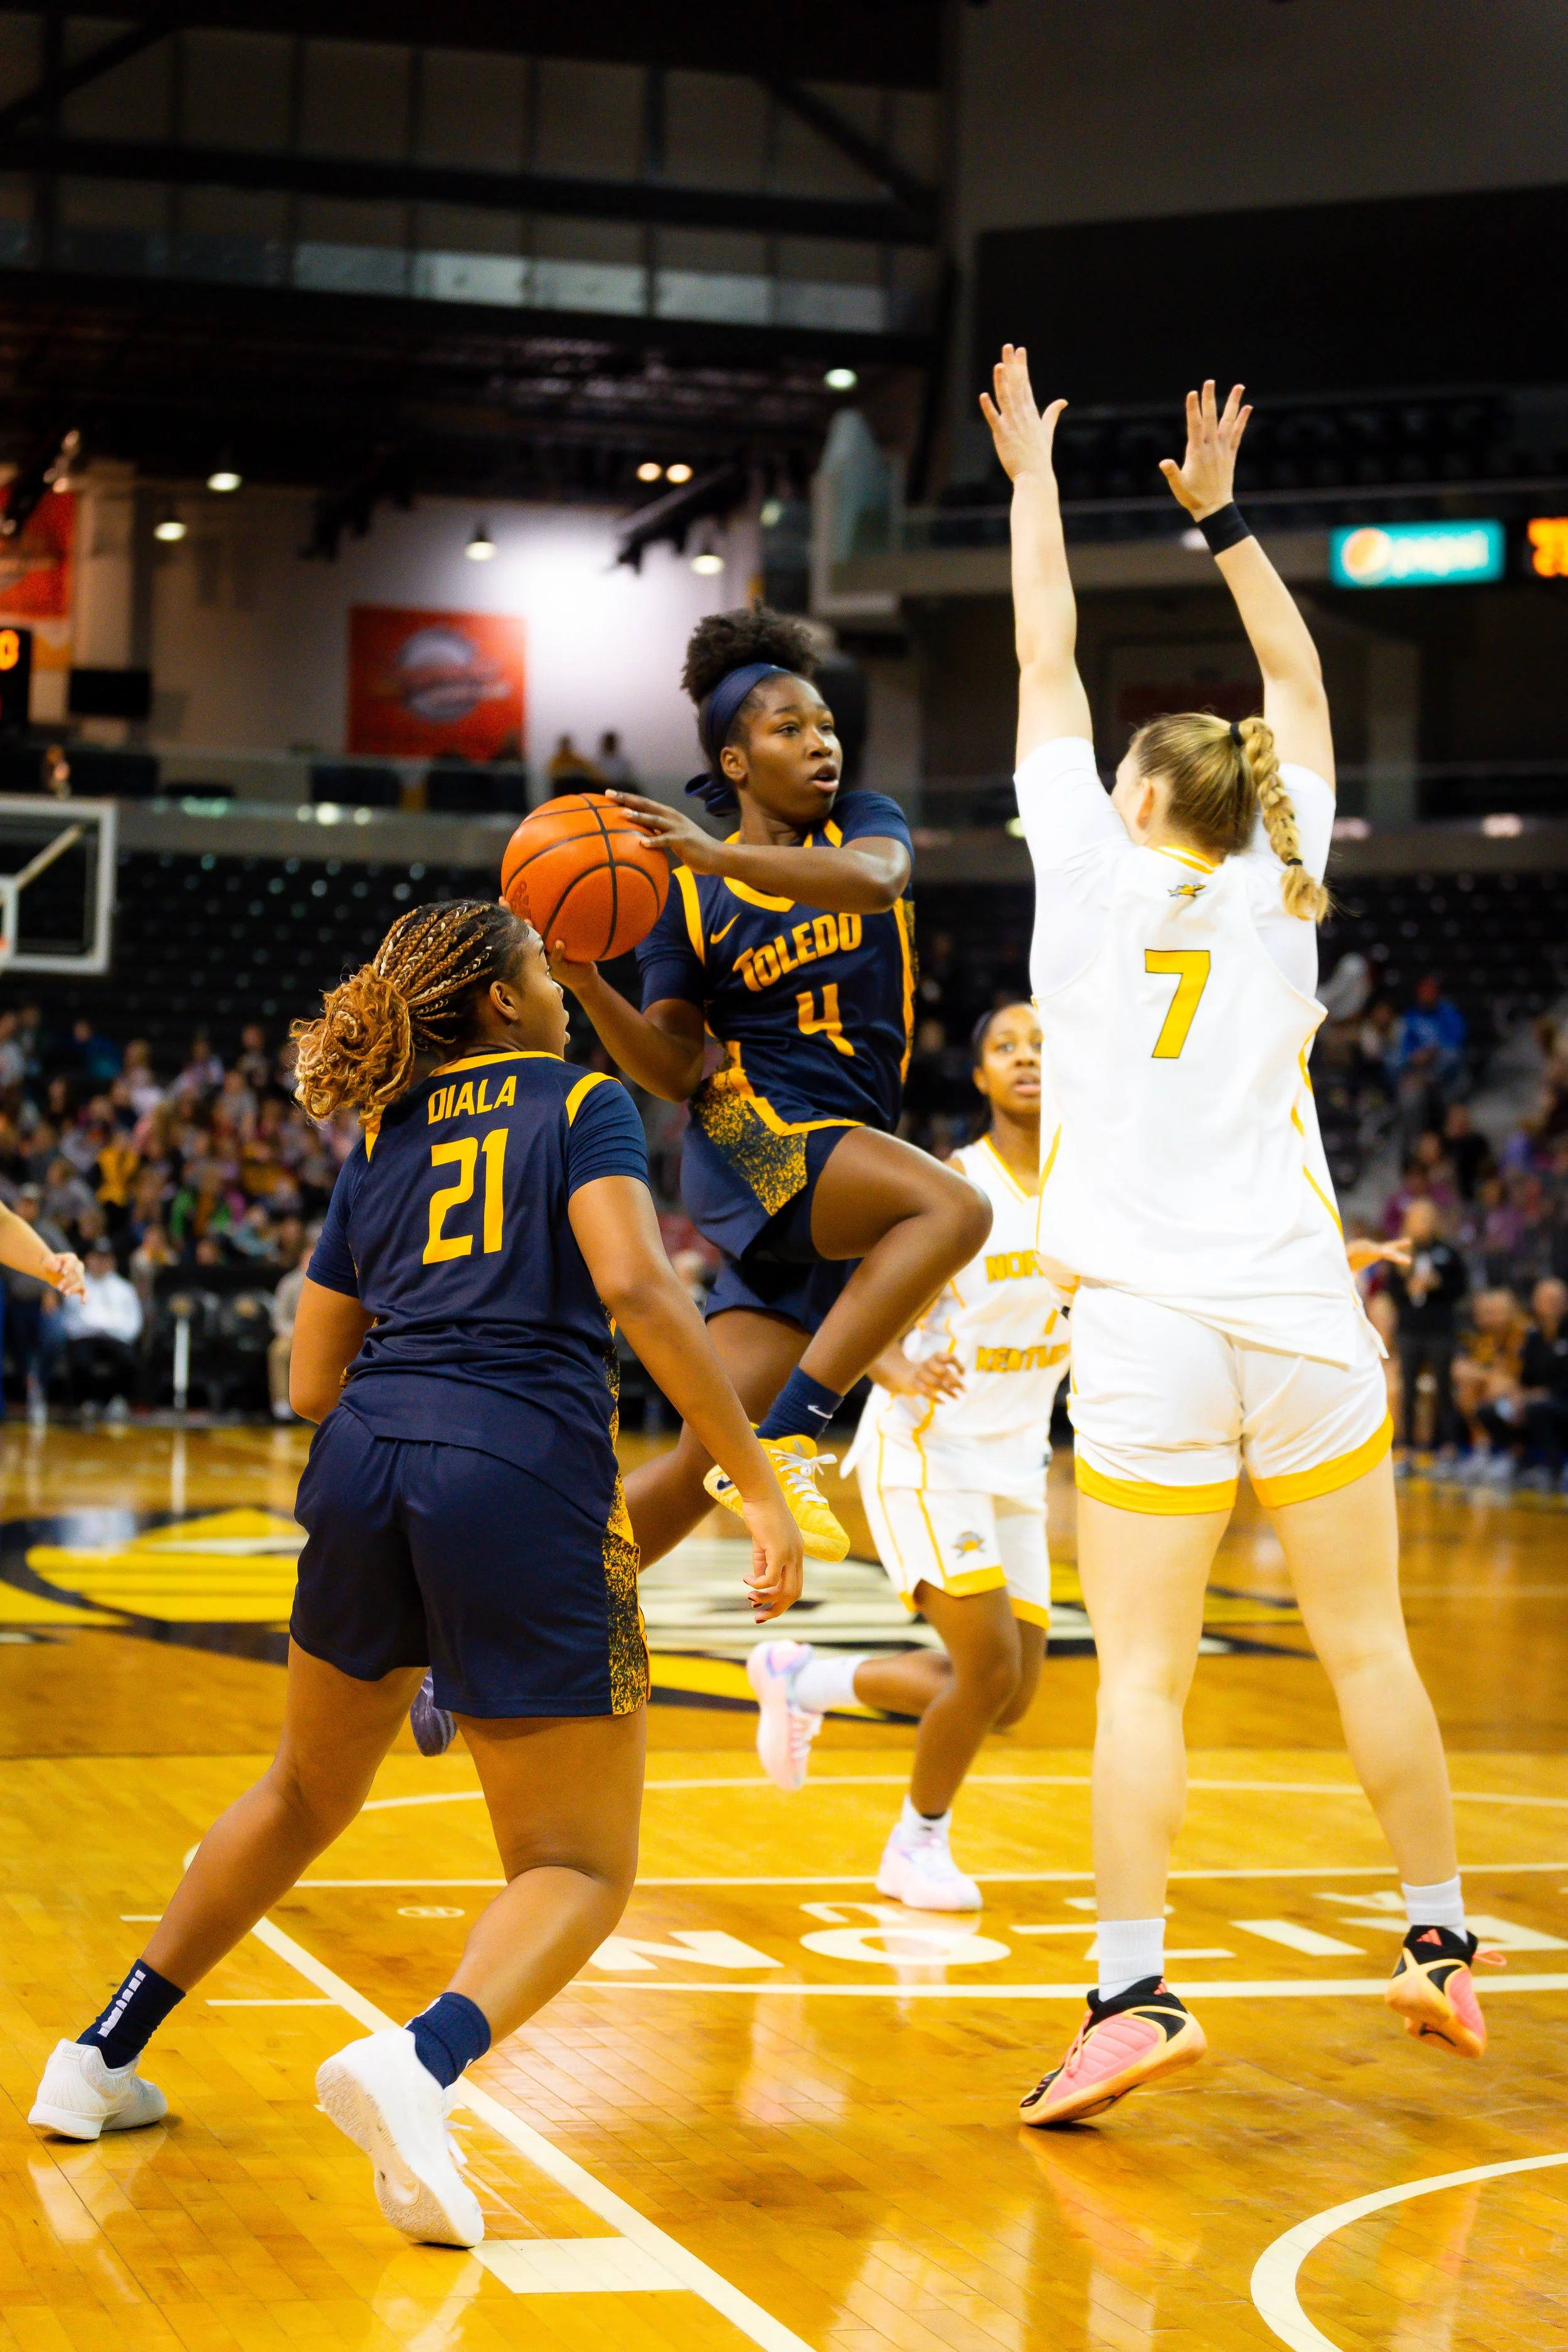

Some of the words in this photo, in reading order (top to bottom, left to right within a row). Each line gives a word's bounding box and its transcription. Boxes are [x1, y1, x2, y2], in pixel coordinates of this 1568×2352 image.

[733, 913, 862, 992] TOLEDO
[797, 983, 856, 1057] 4
[1144, 948, 1211, 1059] 7
[427, 1076, 517, 1125] DIALA
[422, 1128, 509, 1265] 21
